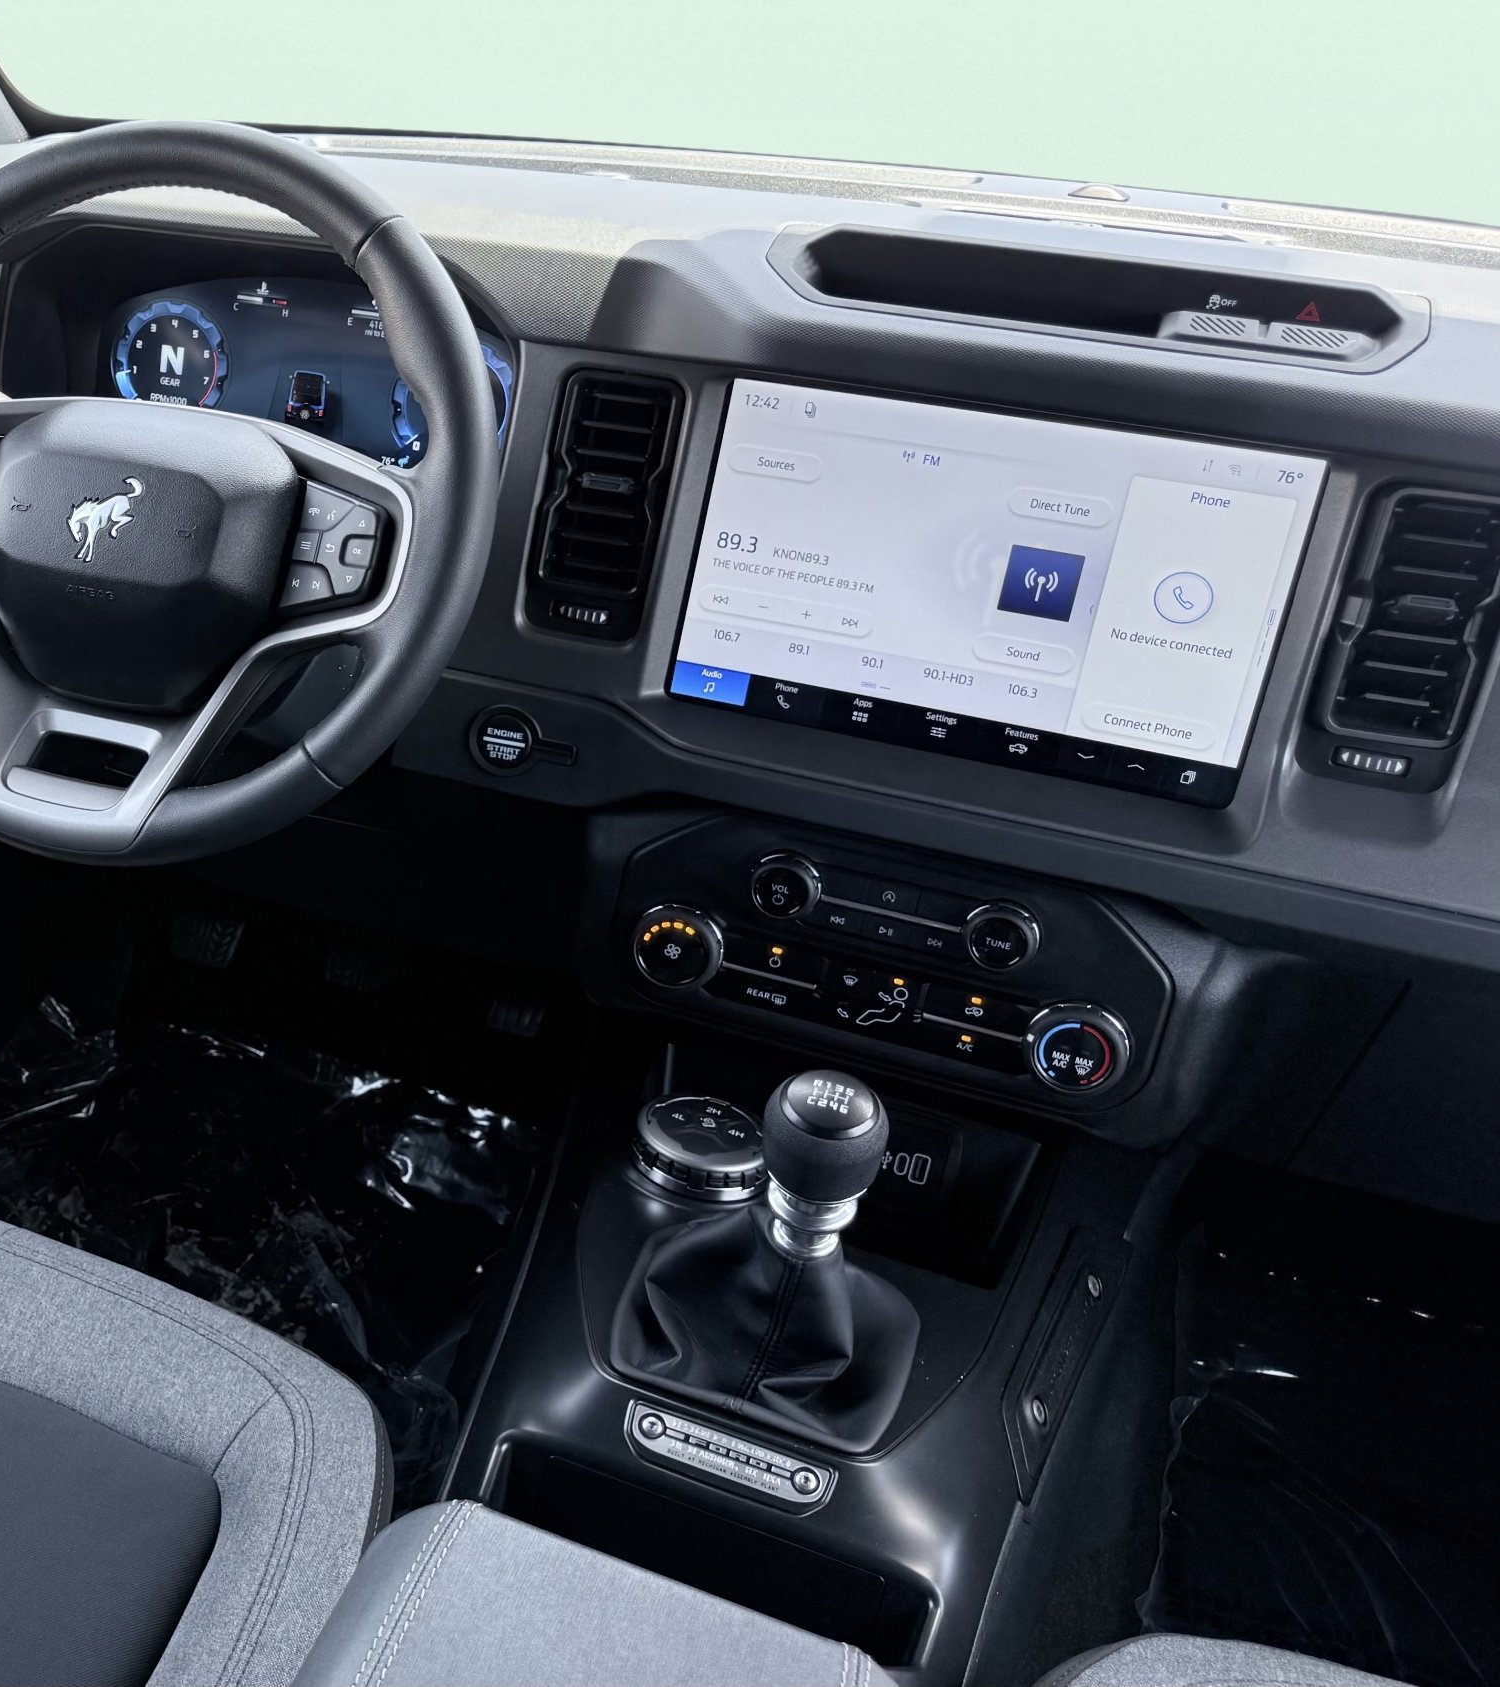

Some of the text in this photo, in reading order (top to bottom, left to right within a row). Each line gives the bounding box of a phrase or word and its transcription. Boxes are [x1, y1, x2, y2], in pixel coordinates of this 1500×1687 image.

[1220, 298, 1237, 308] OFF
[232, 302, 290, 318] C H
[150, 323, 157, 333] 3
[171, 319, 179, 329] 4
[347, 317, 354, 326] E
[192, 329, 199, 339] 5
[135, 340, 143, 349] 2
[159, 344, 185, 376] N
[203, 350, 210, 359] 6
[159, 376, 180, 387] GEAR
[203, 376, 210, 386] 7
[744, 393, 781, 410] 12:42
[757, 456, 796, 472] Sources
[922, 454, 941, 467] FM
[1277, 469, 1304, 485] 76°
[1190, 491, 1231, 509] Phone
[1029, 498, 1091, 517] Direct Tune
[352, 547, 362, 556] OK
[716, 531, 830, 567] 89.3 KNON89.3
[712, 557, 874, 594] THE VOICE OF THE PEOPLE 89.3 FM
[1110, 627, 1233, 659] No device connected
[1005, 646, 1041, 662] Sound
[713, 628, 1038, 699] 106.7 89.1 90.1 90.1-HD3 106.3
[701, 668, 723, 680] Audio
[774, 682, 799, 694] Phone
[853, 697, 873, 709] Apps
[925, 711, 958, 726] Settings
[1103, 713, 1193, 740] Connect Phone
[486, 727, 524, 740] ENGINE
[1004, 727, 1039, 742] Features
[486, 743, 521, 756] START
[489, 750, 517, 761] STOP
[770, 882, 789, 895] VOL
[984, 936, 1012, 951] TUNE
[746, 986, 771, 1001] REAR
[955, 1042, 974, 1052] A/C
[1051, 1050, 1071, 1063] MAX
[1074, 1056, 1094, 1068] MAX
[1052, 1058, 1068, 1069] A/C
[825, 1081, 832, 1090] 1
[834, 1083, 844, 1093] 3
[845, 1087, 855, 1097] 5
[705, 1106, 722, 1116] 2H
[806, 1095, 849, 1115] C 2 4 6
[671, 1113, 685, 1121] 4L
[727, 1129, 746, 1139] 4H
[666, 1447, 685, 1459] BUILT
[760, 1480, 779, 1494] PLANT
